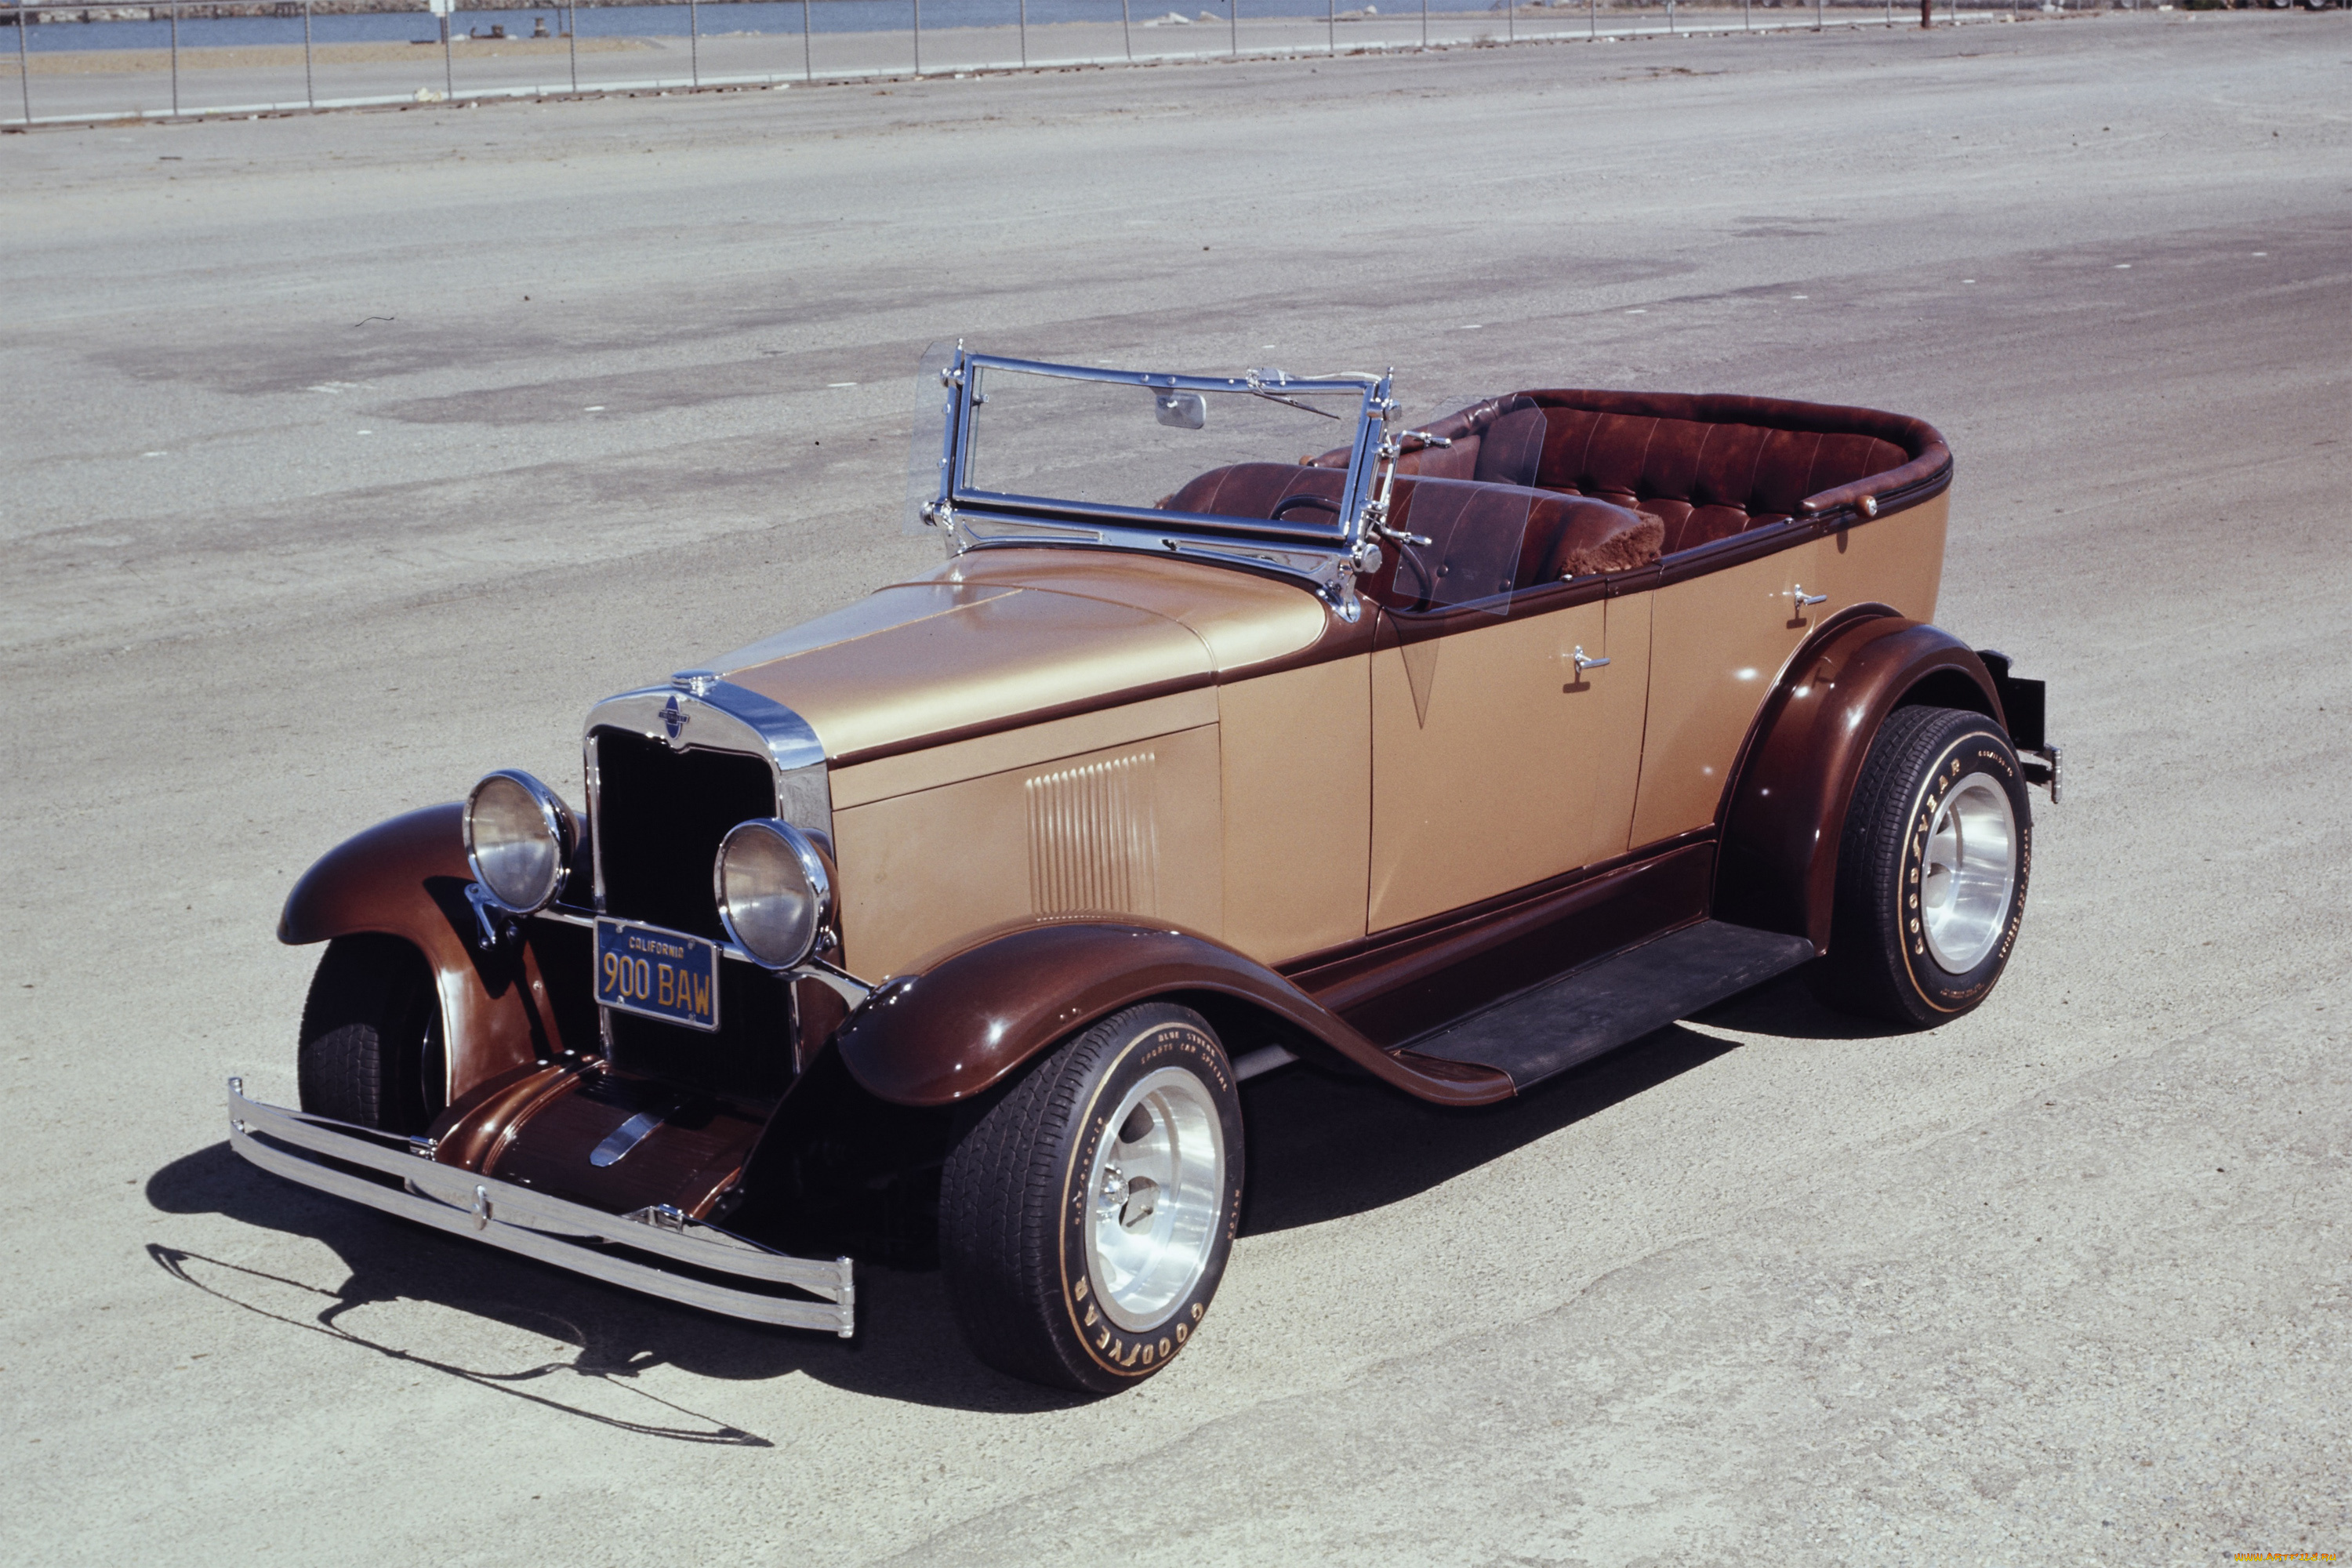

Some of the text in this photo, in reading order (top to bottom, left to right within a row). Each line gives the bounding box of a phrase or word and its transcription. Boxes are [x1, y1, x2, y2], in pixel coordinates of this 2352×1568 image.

[1909, 758, 1960, 955] GOODYEAR
[629, 936, 684, 959] CALIFORNIA
[604, 952, 710, 1015] 900 BAW
[1158, 1031, 1179, 1042] BLUE
[1227, 1189, 1240, 1240] NYLON
[1074, 1274, 1203, 1367] GOODYEAR
